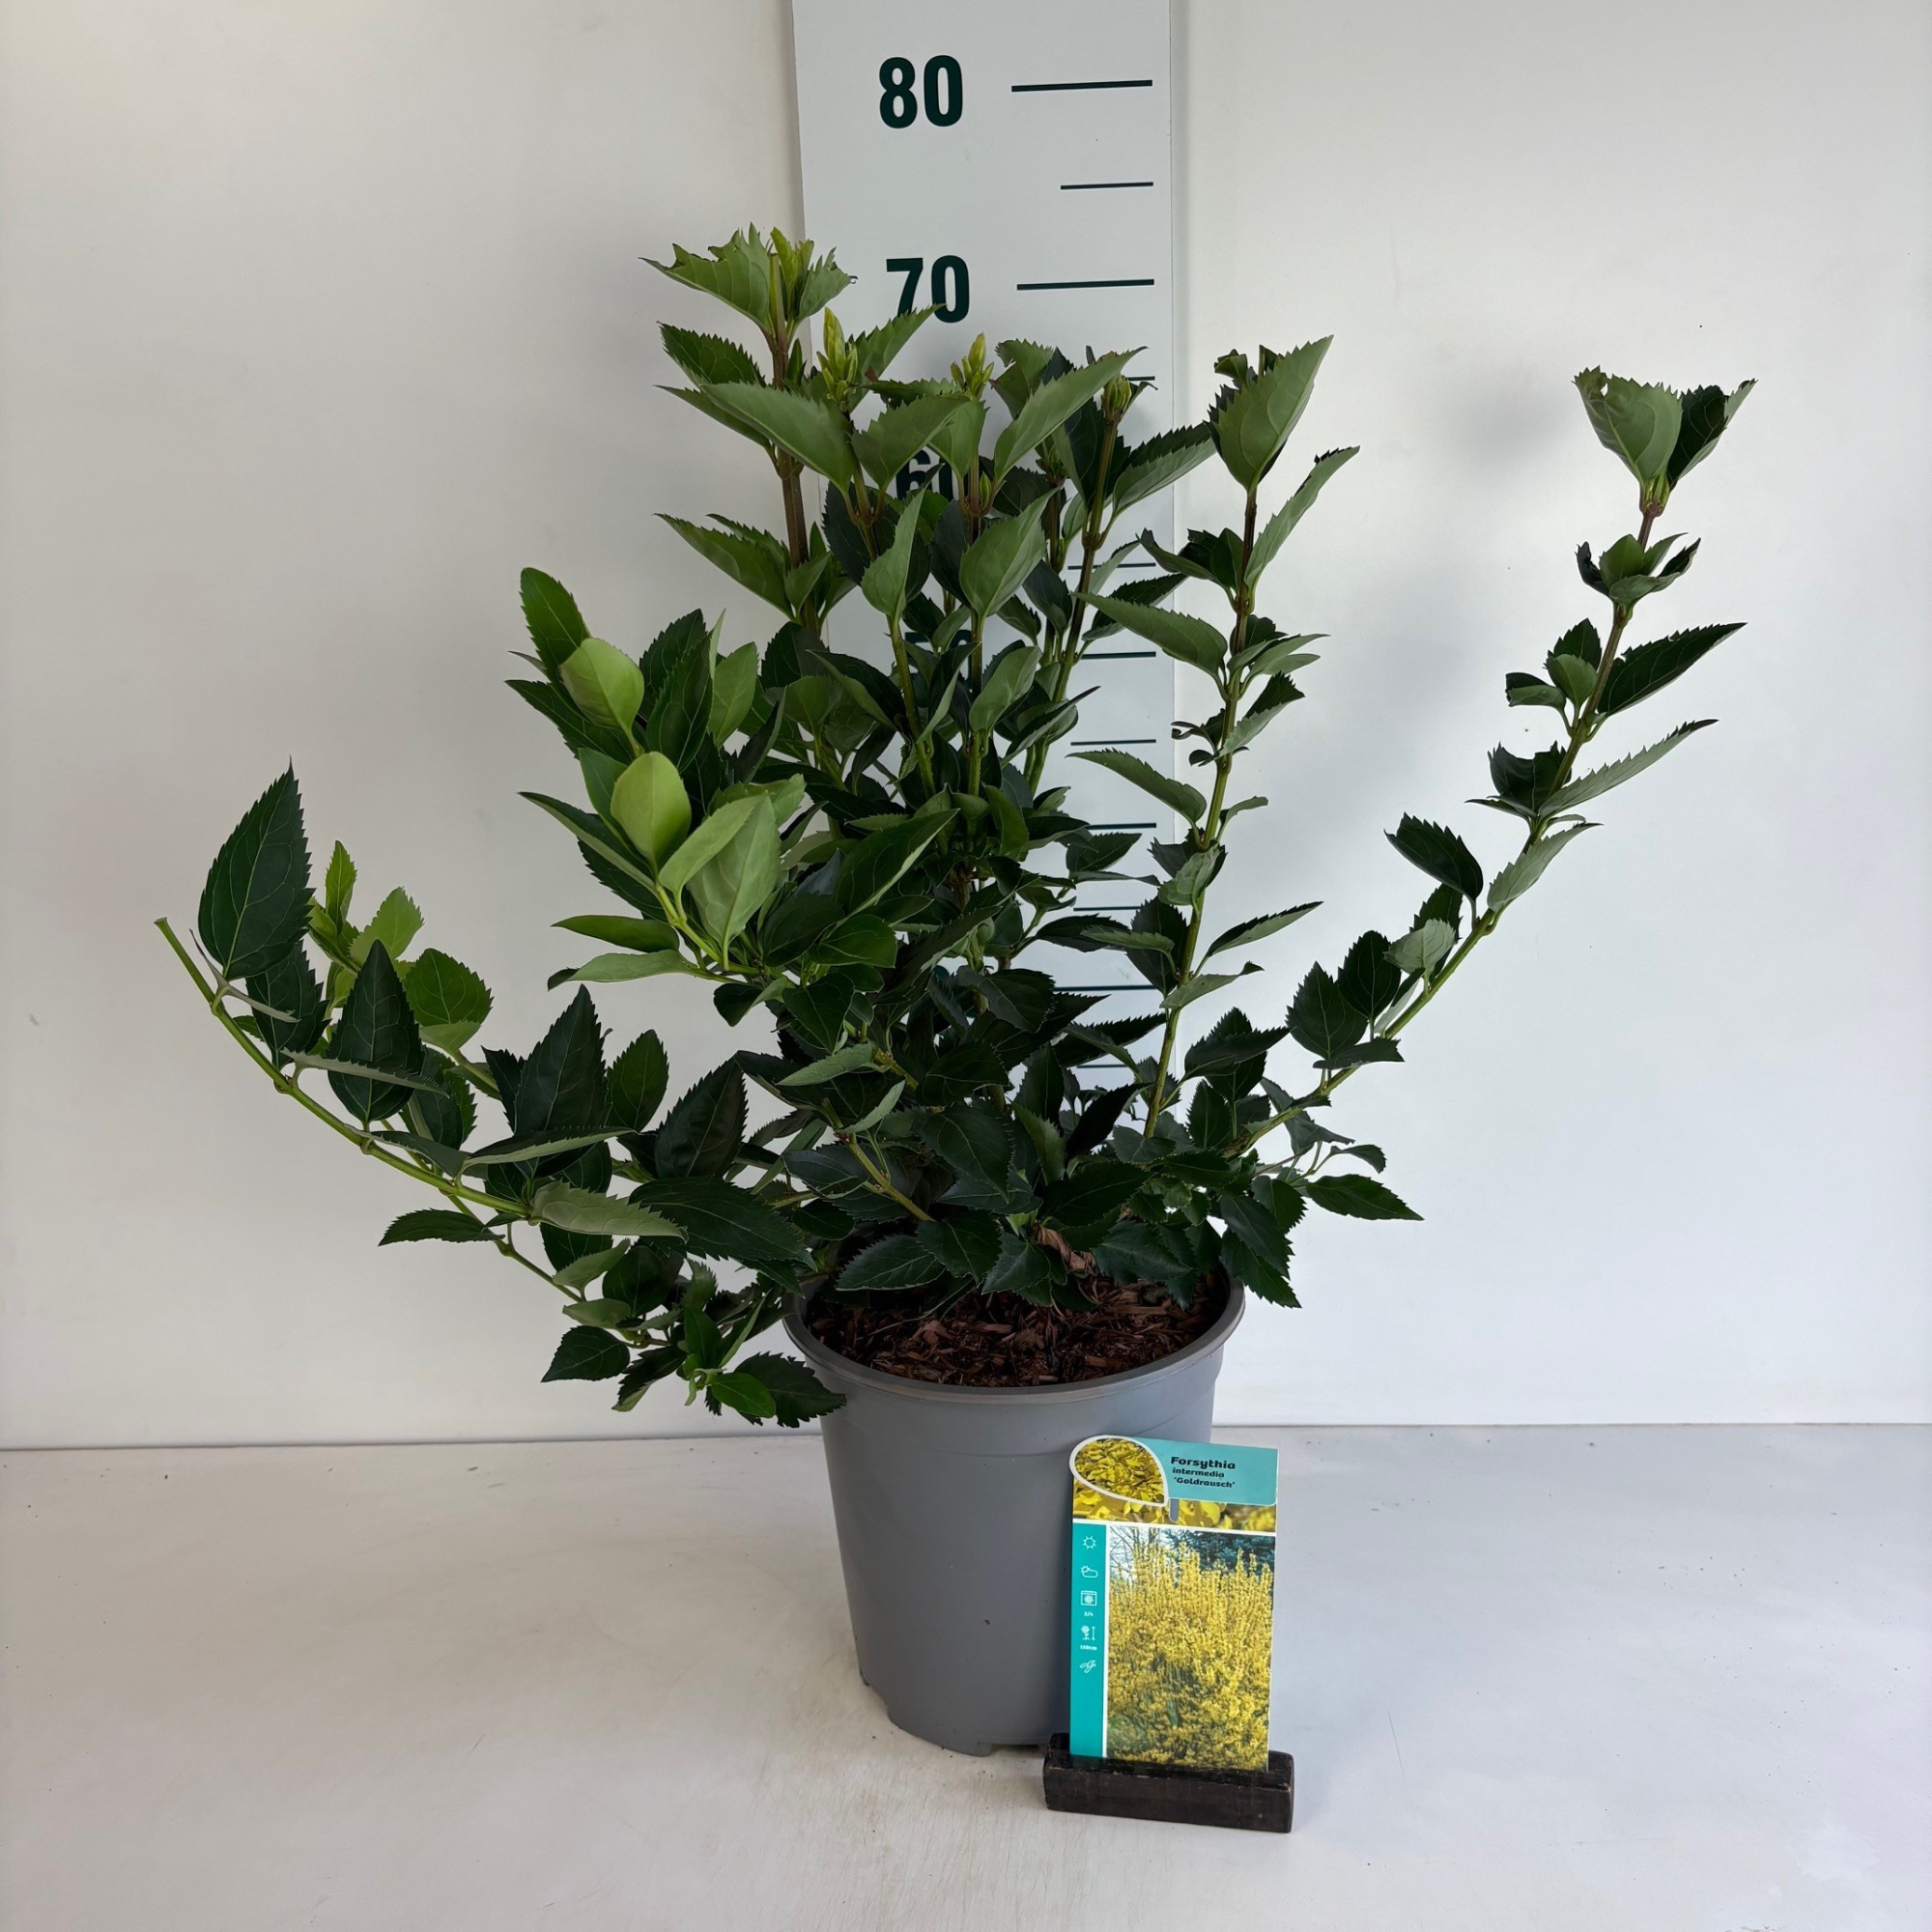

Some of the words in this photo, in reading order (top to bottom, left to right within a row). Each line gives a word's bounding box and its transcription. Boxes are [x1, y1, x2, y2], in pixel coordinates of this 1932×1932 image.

[878, 54, 964, 129] 80
[886, 254, 970, 324] 70
[1171, 1456, 1236, 1469] Forsythia
[1172, 1467, 1225, 1478] intermedia
